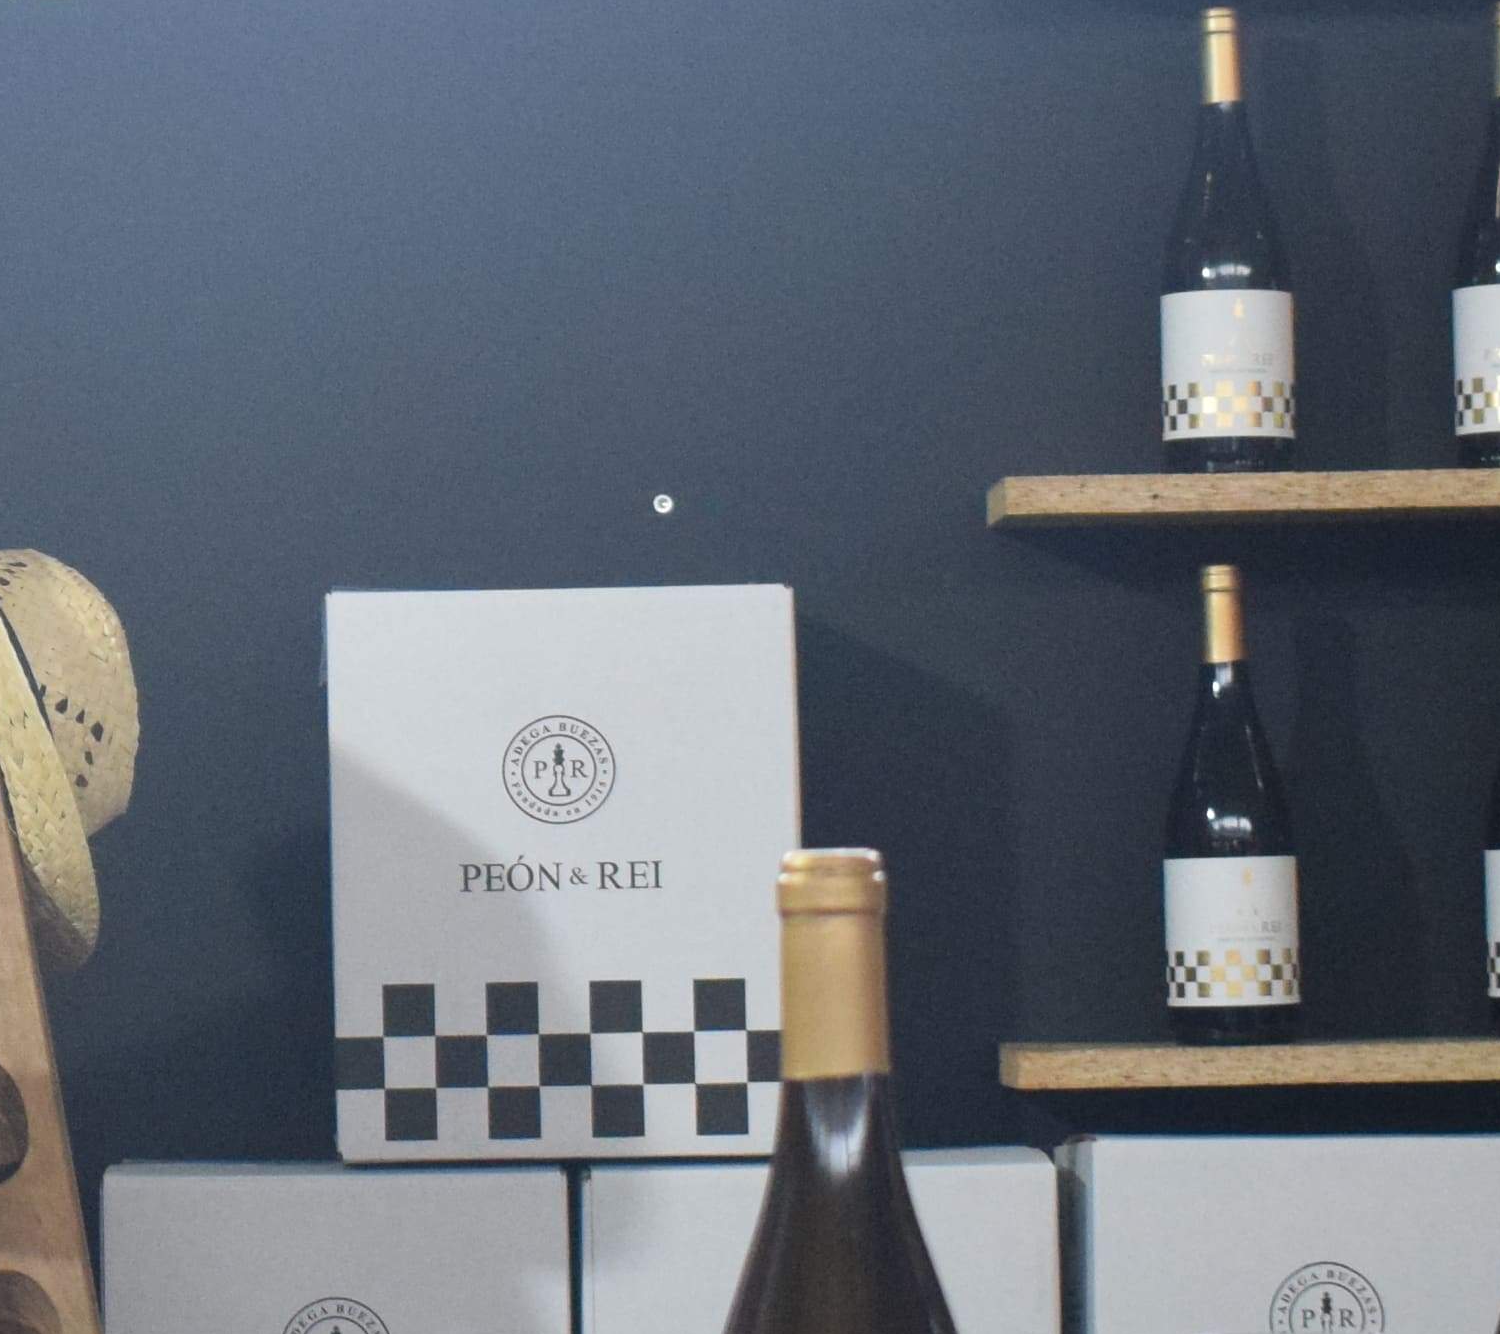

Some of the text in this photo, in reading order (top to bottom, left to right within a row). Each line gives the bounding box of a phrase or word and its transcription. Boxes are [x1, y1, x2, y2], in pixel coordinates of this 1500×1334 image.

[511, 722, 608, 766] ADEGA BUEZAS
[533, 759, 589, 779] P R
[458, 855, 663, 893] PEÓN & REI
[1279, 1270, 1377, 1315] ADEGA BUEZAS
[1302, 1308, 1356, 1328] P R
